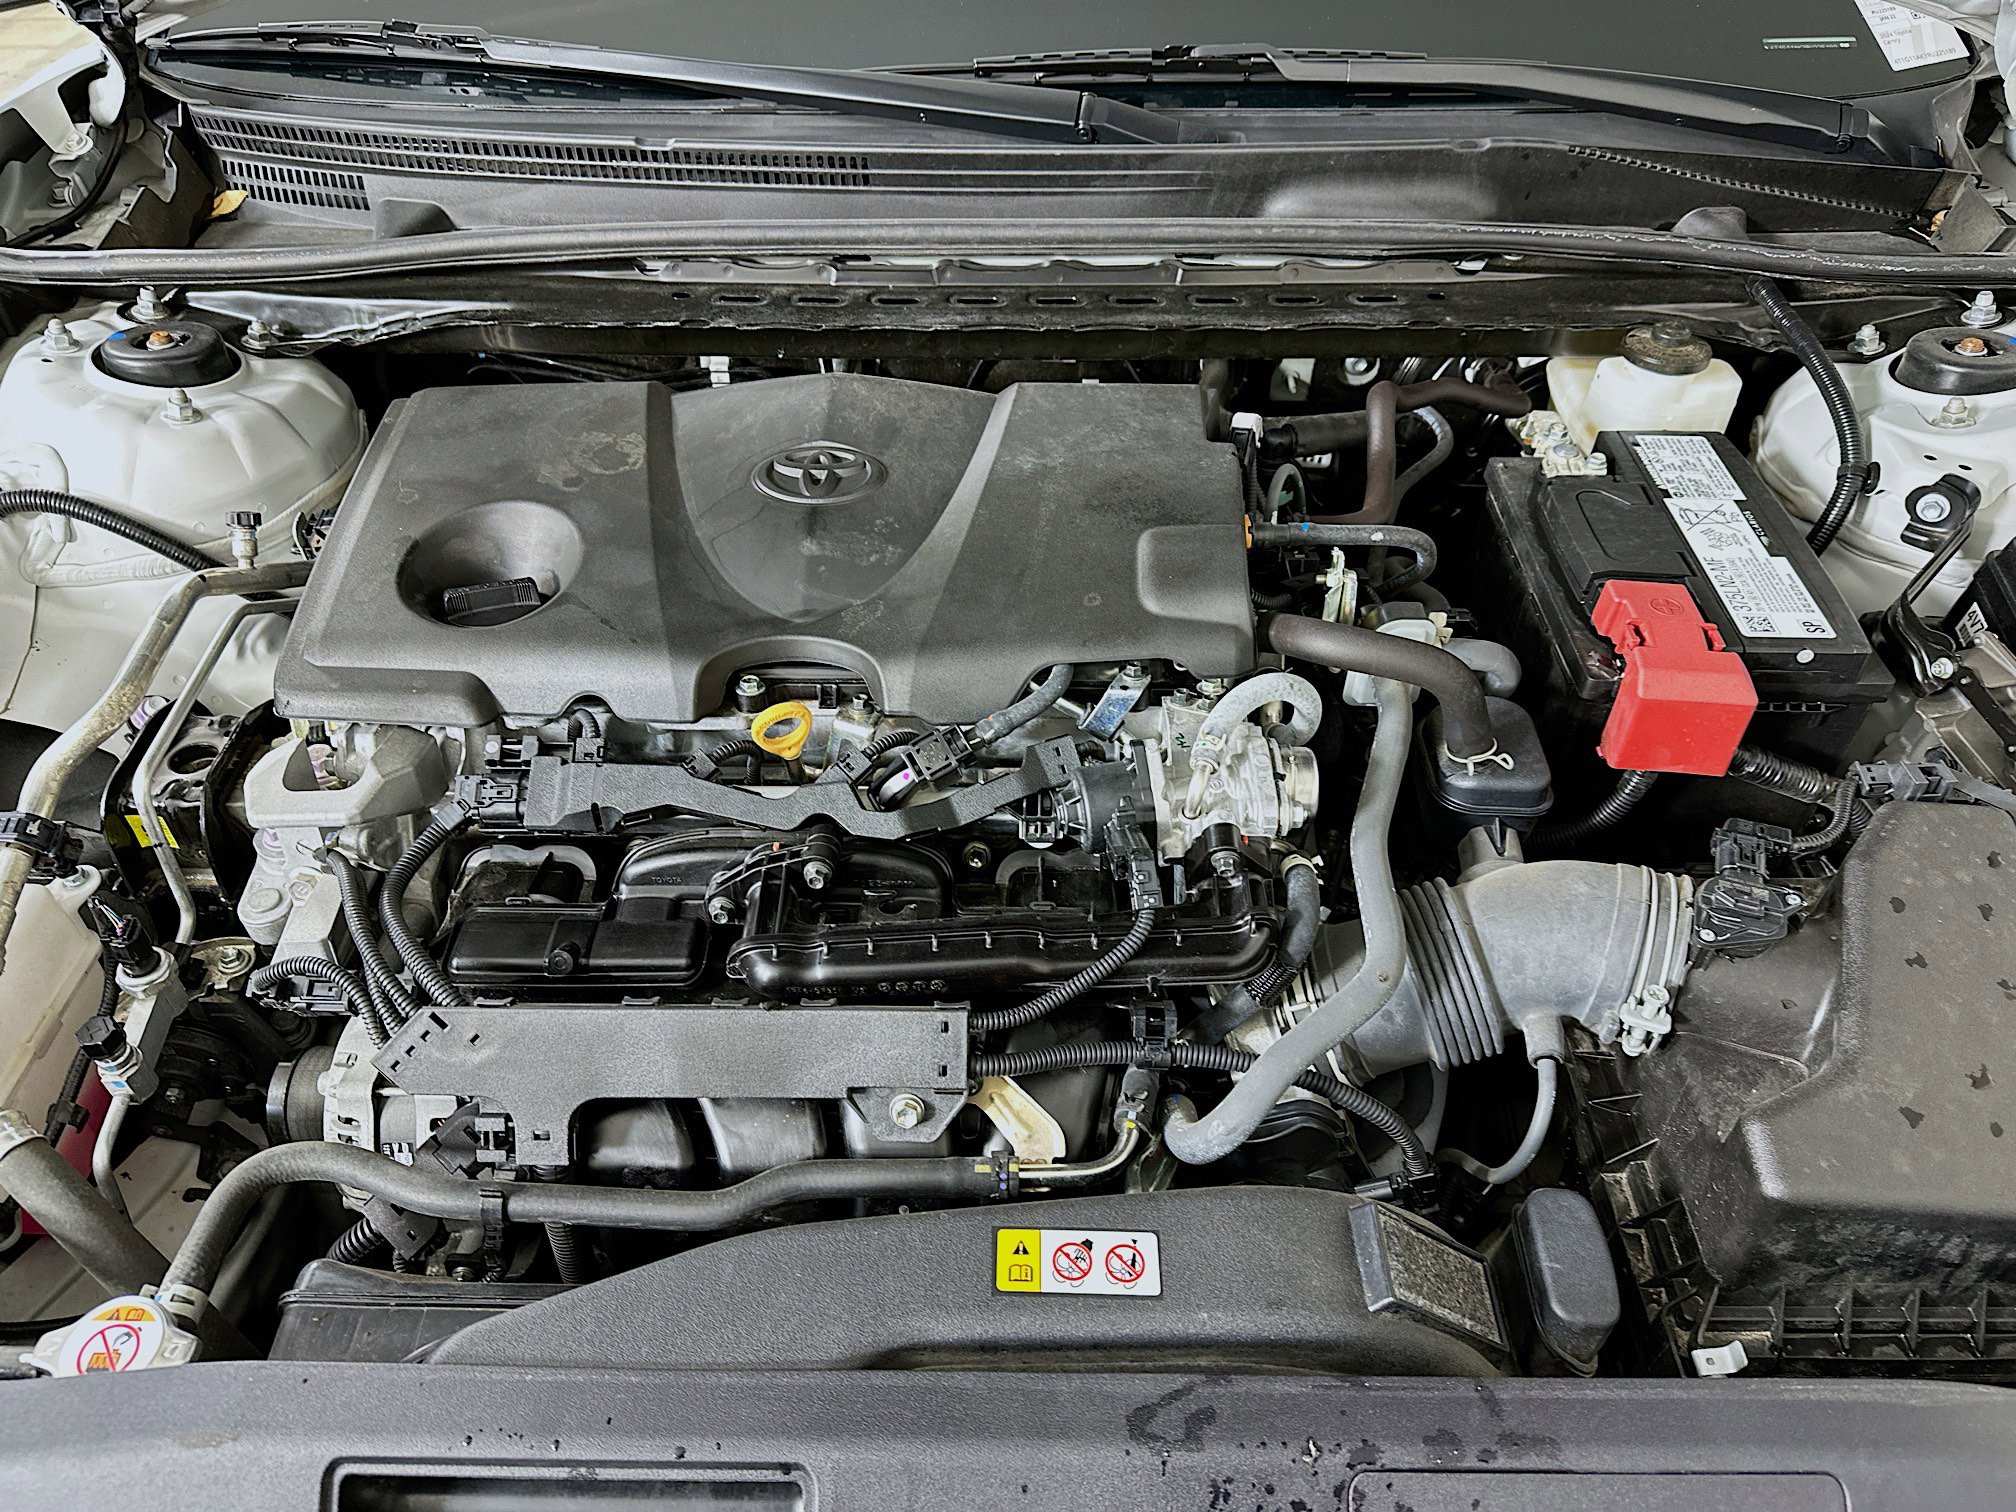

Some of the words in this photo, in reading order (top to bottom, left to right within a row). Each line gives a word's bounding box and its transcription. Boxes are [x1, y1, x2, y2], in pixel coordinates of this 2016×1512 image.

[1894, 28, 1912, 37] Toyota
[1883, 38, 1901, 46] Camry
[1742, 510, 1765, 536] CLARIOS
[1703, 556, 1752, 612] 375LN2-MF
[1802, 621, 1826, 634] SP
[651, 876, 687, 884] TOYOTA
